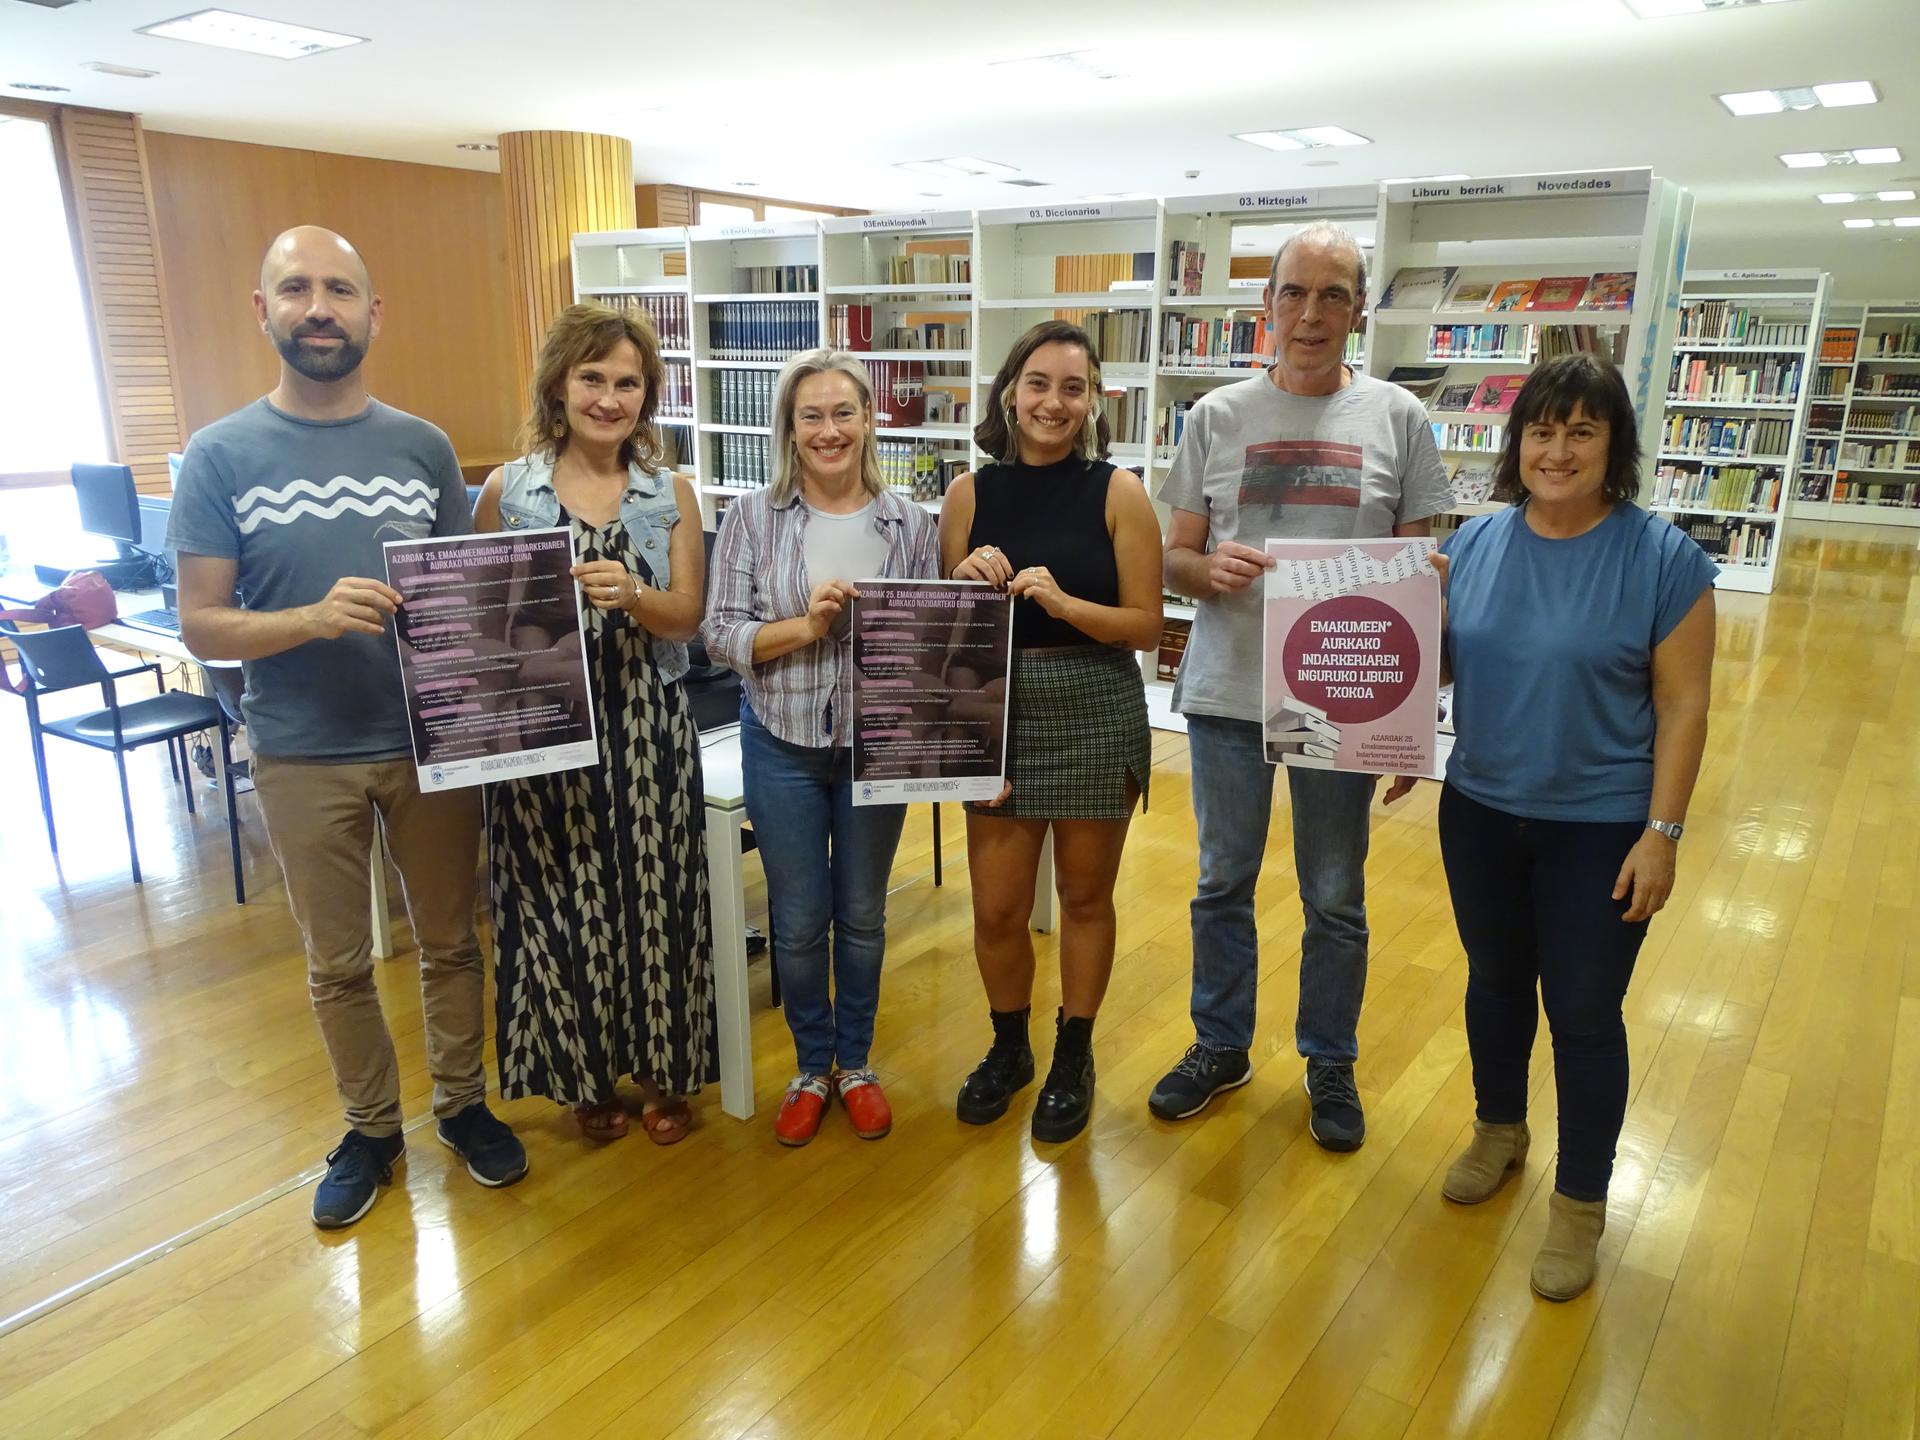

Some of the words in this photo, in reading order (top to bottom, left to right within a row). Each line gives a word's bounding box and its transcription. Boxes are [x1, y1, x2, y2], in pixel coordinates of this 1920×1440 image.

[1412, 188, 1450, 198] Liburu
[1460, 184, 1504, 195] berriak
[1537, 179, 1611, 191] Novedades
[1239, 197, 1255, 207] 03.
[1258, 195, 1308, 207] Hiztegiak
[1045, 207, 1101, 217] Diccionarios
[430, 559, 463, 571] AURKAKO
[1321, 637, 1381, 650] AURKAKO
[1302, 653, 1399, 666] INDARKERIAREN
[1298, 669, 1357, 682] INGURUKO
[1359, 670, 1403, 683] LIBURU
[1325, 686, 1374, 699] TXOKOA
[1371, 734, 1403, 742] AZAROAK
